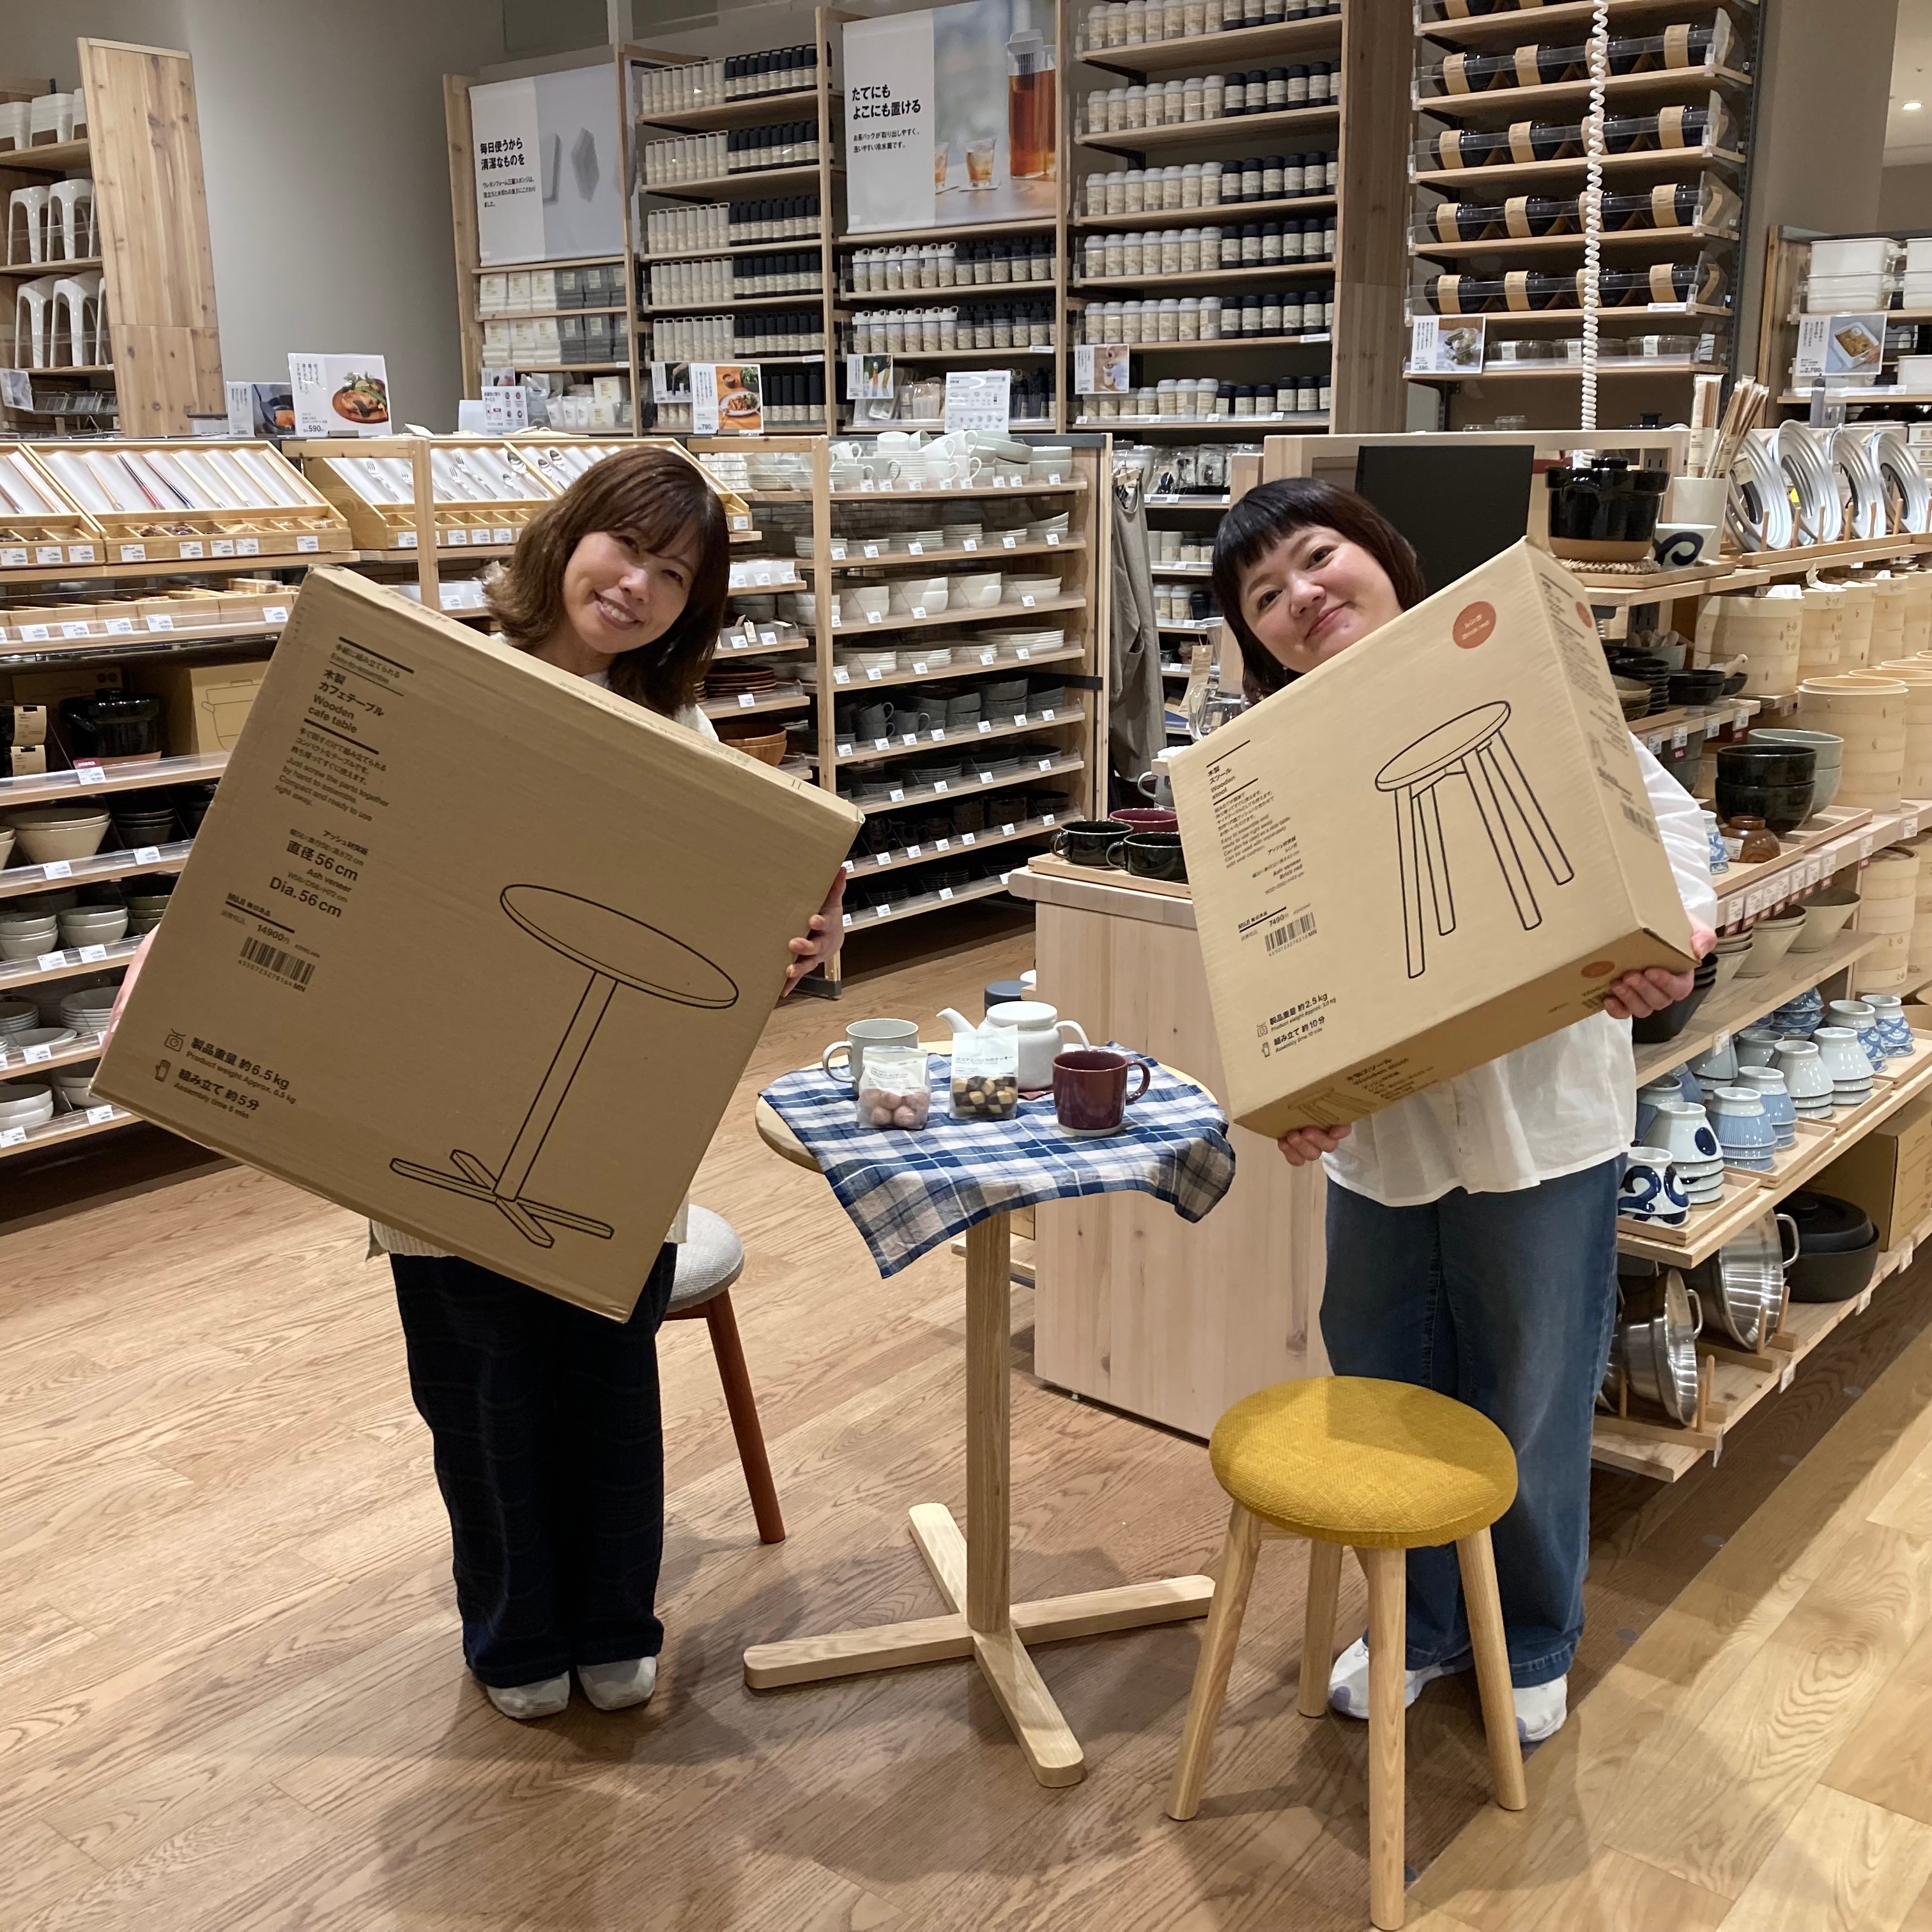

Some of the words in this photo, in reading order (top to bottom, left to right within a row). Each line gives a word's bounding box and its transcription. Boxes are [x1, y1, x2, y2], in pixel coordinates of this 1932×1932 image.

[852, 84, 891, 101] たてにも
[853, 99, 921, 120] よこにも置ける
[480, 137, 523, 154] 毎日使うから
[480, 153, 525, 171] 清潔なものを
[323, 670, 346, 685] 木製
[314, 694, 354, 719] Wooden
[319, 682, 384, 716] カフェテーブル
[309, 707, 330, 721] cafe
[332, 716, 357, 733] table
[282, 765, 293, 775] by
[293, 770, 312, 783] hand
[1211, 776, 1236, 793] Wooden
[279, 775, 313, 795] Compact
[312, 790, 328, 801] and
[328, 798, 349, 811] ready
[358, 812, 372, 822] use
[1212, 787, 1227, 800] stool
[286, 840, 315, 861] 直径
[335, 865, 358, 881] cm
[307, 869, 323, 880] Ash
[325, 877, 352, 893] veneer
[269, 877, 296, 898] Dia.
[298, 890, 318, 906] 56
[319, 901, 342, 917] cm
[1271, 1021, 1289, 1032] Product
[1274, 1028, 1300, 1045] 組み立て
[191, 1038, 238, 1066] 製品重量
[178, 1069, 224, 1095] 組み立て
[186, 1051, 217, 1068] Product
[273, 1089, 286, 1098] 6.5
[286, 1094, 296, 1104] kg
[234, 1110, 249, 1119] min
